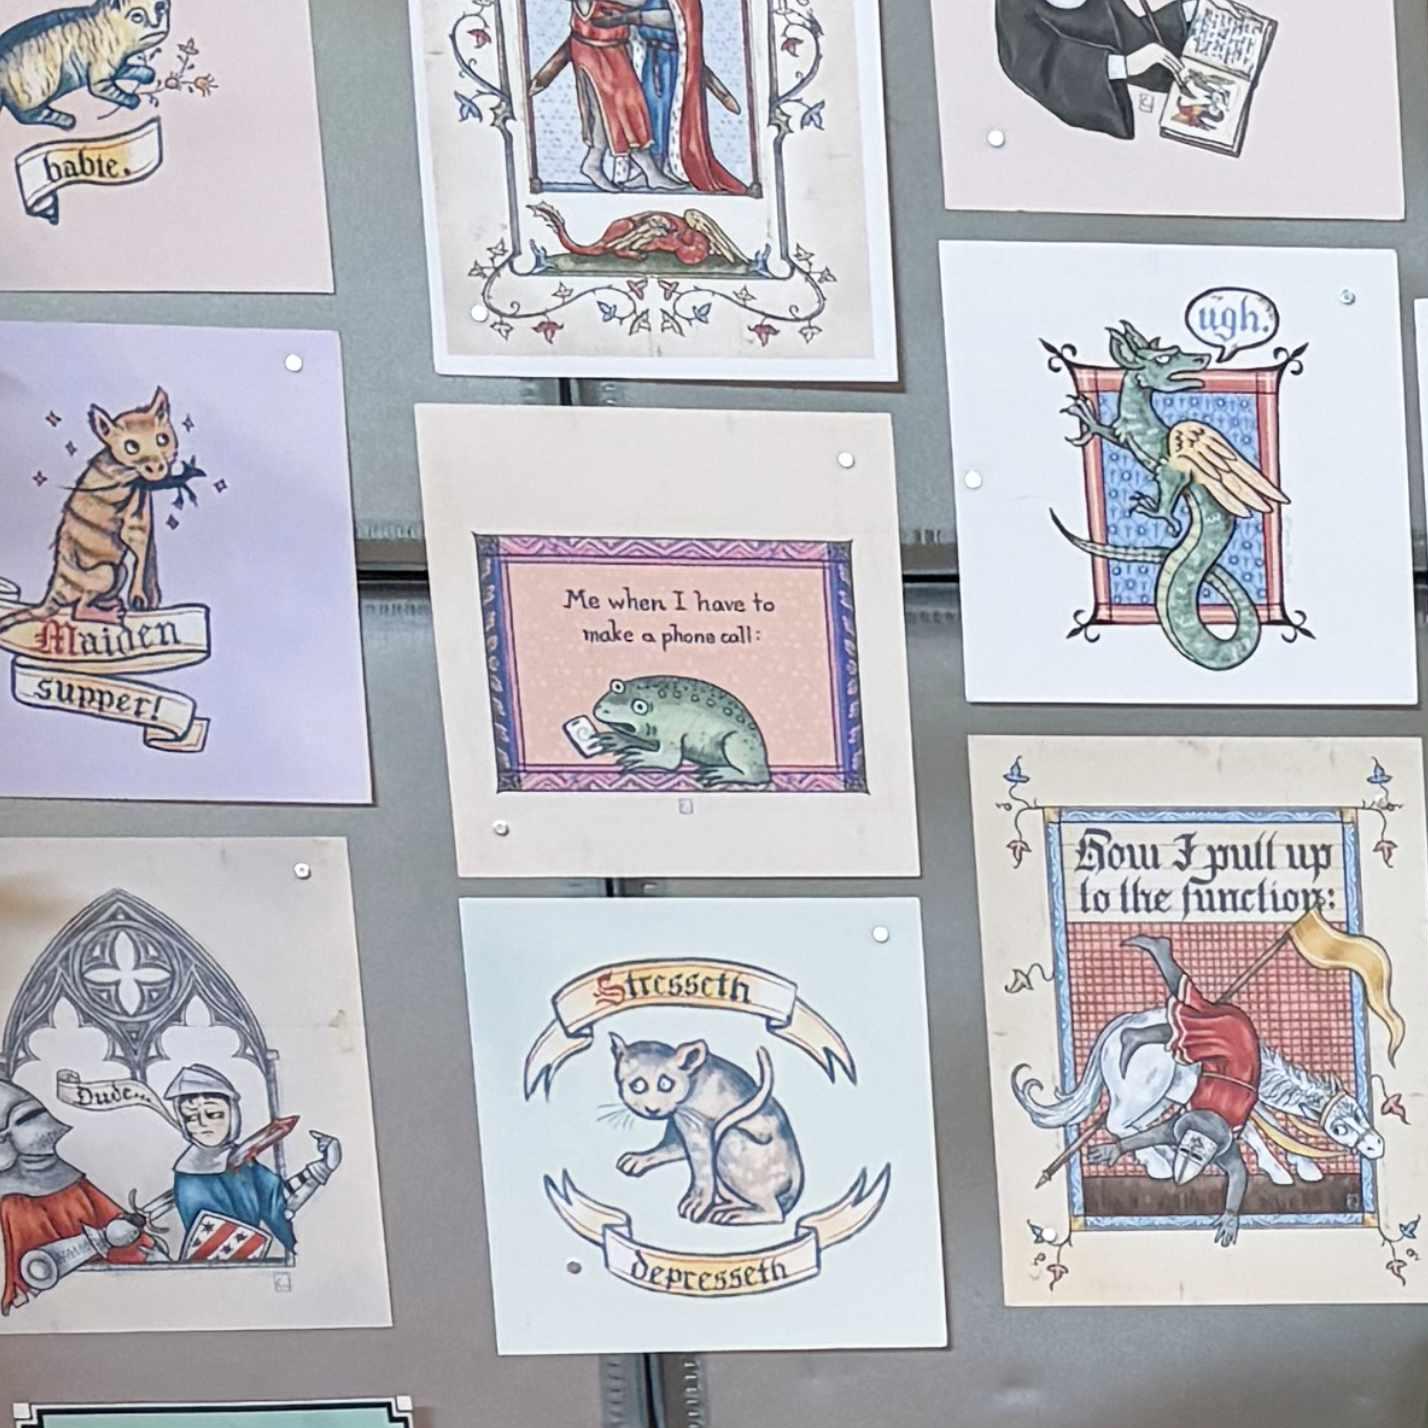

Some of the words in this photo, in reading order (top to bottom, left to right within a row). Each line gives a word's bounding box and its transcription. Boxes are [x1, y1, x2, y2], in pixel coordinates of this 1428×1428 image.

[1198, 297, 1270, 344] ugh.
[564, 589, 600, 612] Me
[609, 590, 666, 613] when
[673, 590, 687, 613] I
[695, 590, 746, 614] have
[752, 594, 776, 614] to
[583, 623, 634, 646] make
[641, 628, 656, 646] a
[661, 624, 715, 653] phone
[720, 623, 763, 646] call:
[33, 673, 163, 723] supper!
[1204, 832, 1278, 885] pull
[1287, 840, 1331, 885] up
[1081, 886, 1110, 914] to
[1120, 884, 1172, 915] the
[1179, 884, 1337, 922] function:
[594, 972, 751, 1004] Stresseth
[629, 1253, 788, 1291] depresseth
